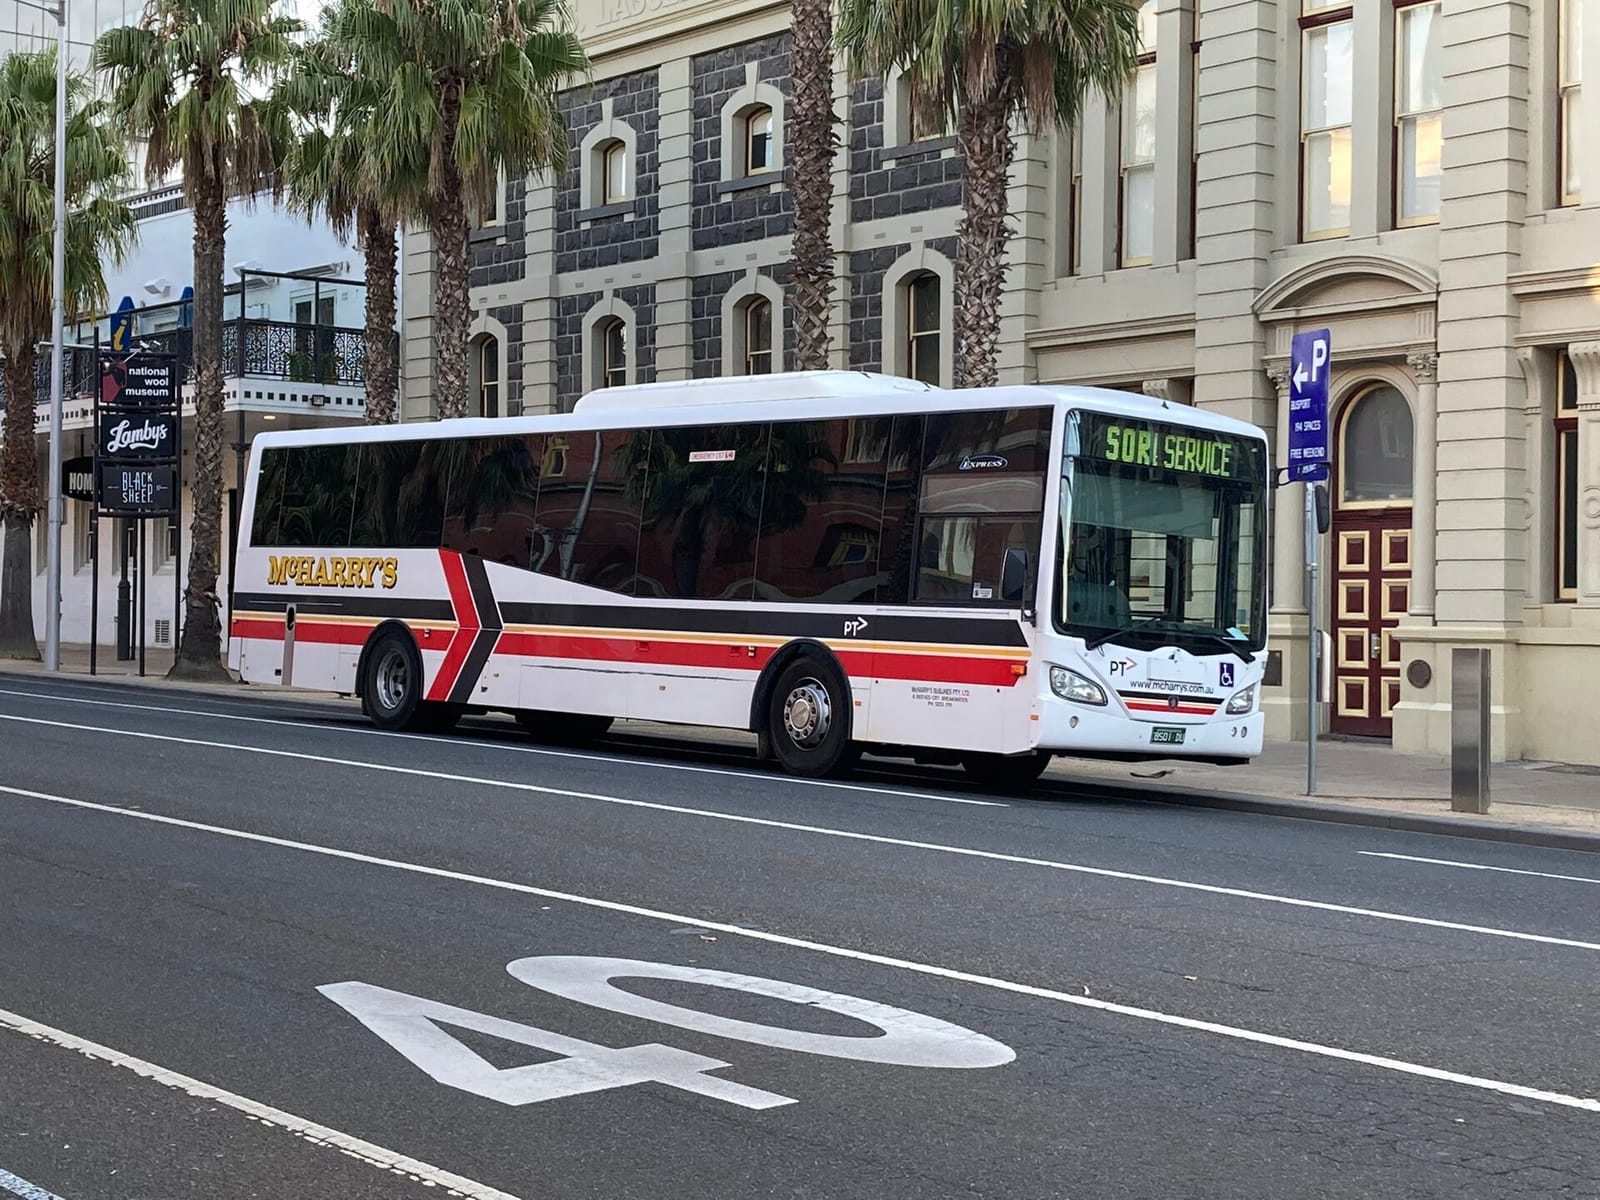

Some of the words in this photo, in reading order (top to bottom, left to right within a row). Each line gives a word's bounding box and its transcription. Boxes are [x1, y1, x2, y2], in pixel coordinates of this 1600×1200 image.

[1311, 339, 1327, 382] P
[128, 366, 169, 376] national
[144, 377, 169, 386] wool
[125, 388, 169, 396] museum
[107, 419, 168, 453] Lambys
[1163, 434, 1232, 477] SERVICE
[1290, 448, 1302, 459] FREE
[69, 472, 93, 491] HOM
[122, 471, 153, 492] BLACK
[122, 488, 153, 503] SHEEP
[1130, 680, 1214, 694] www.mcharrys.com.au
[314, 955, 1017, 1110] 40
